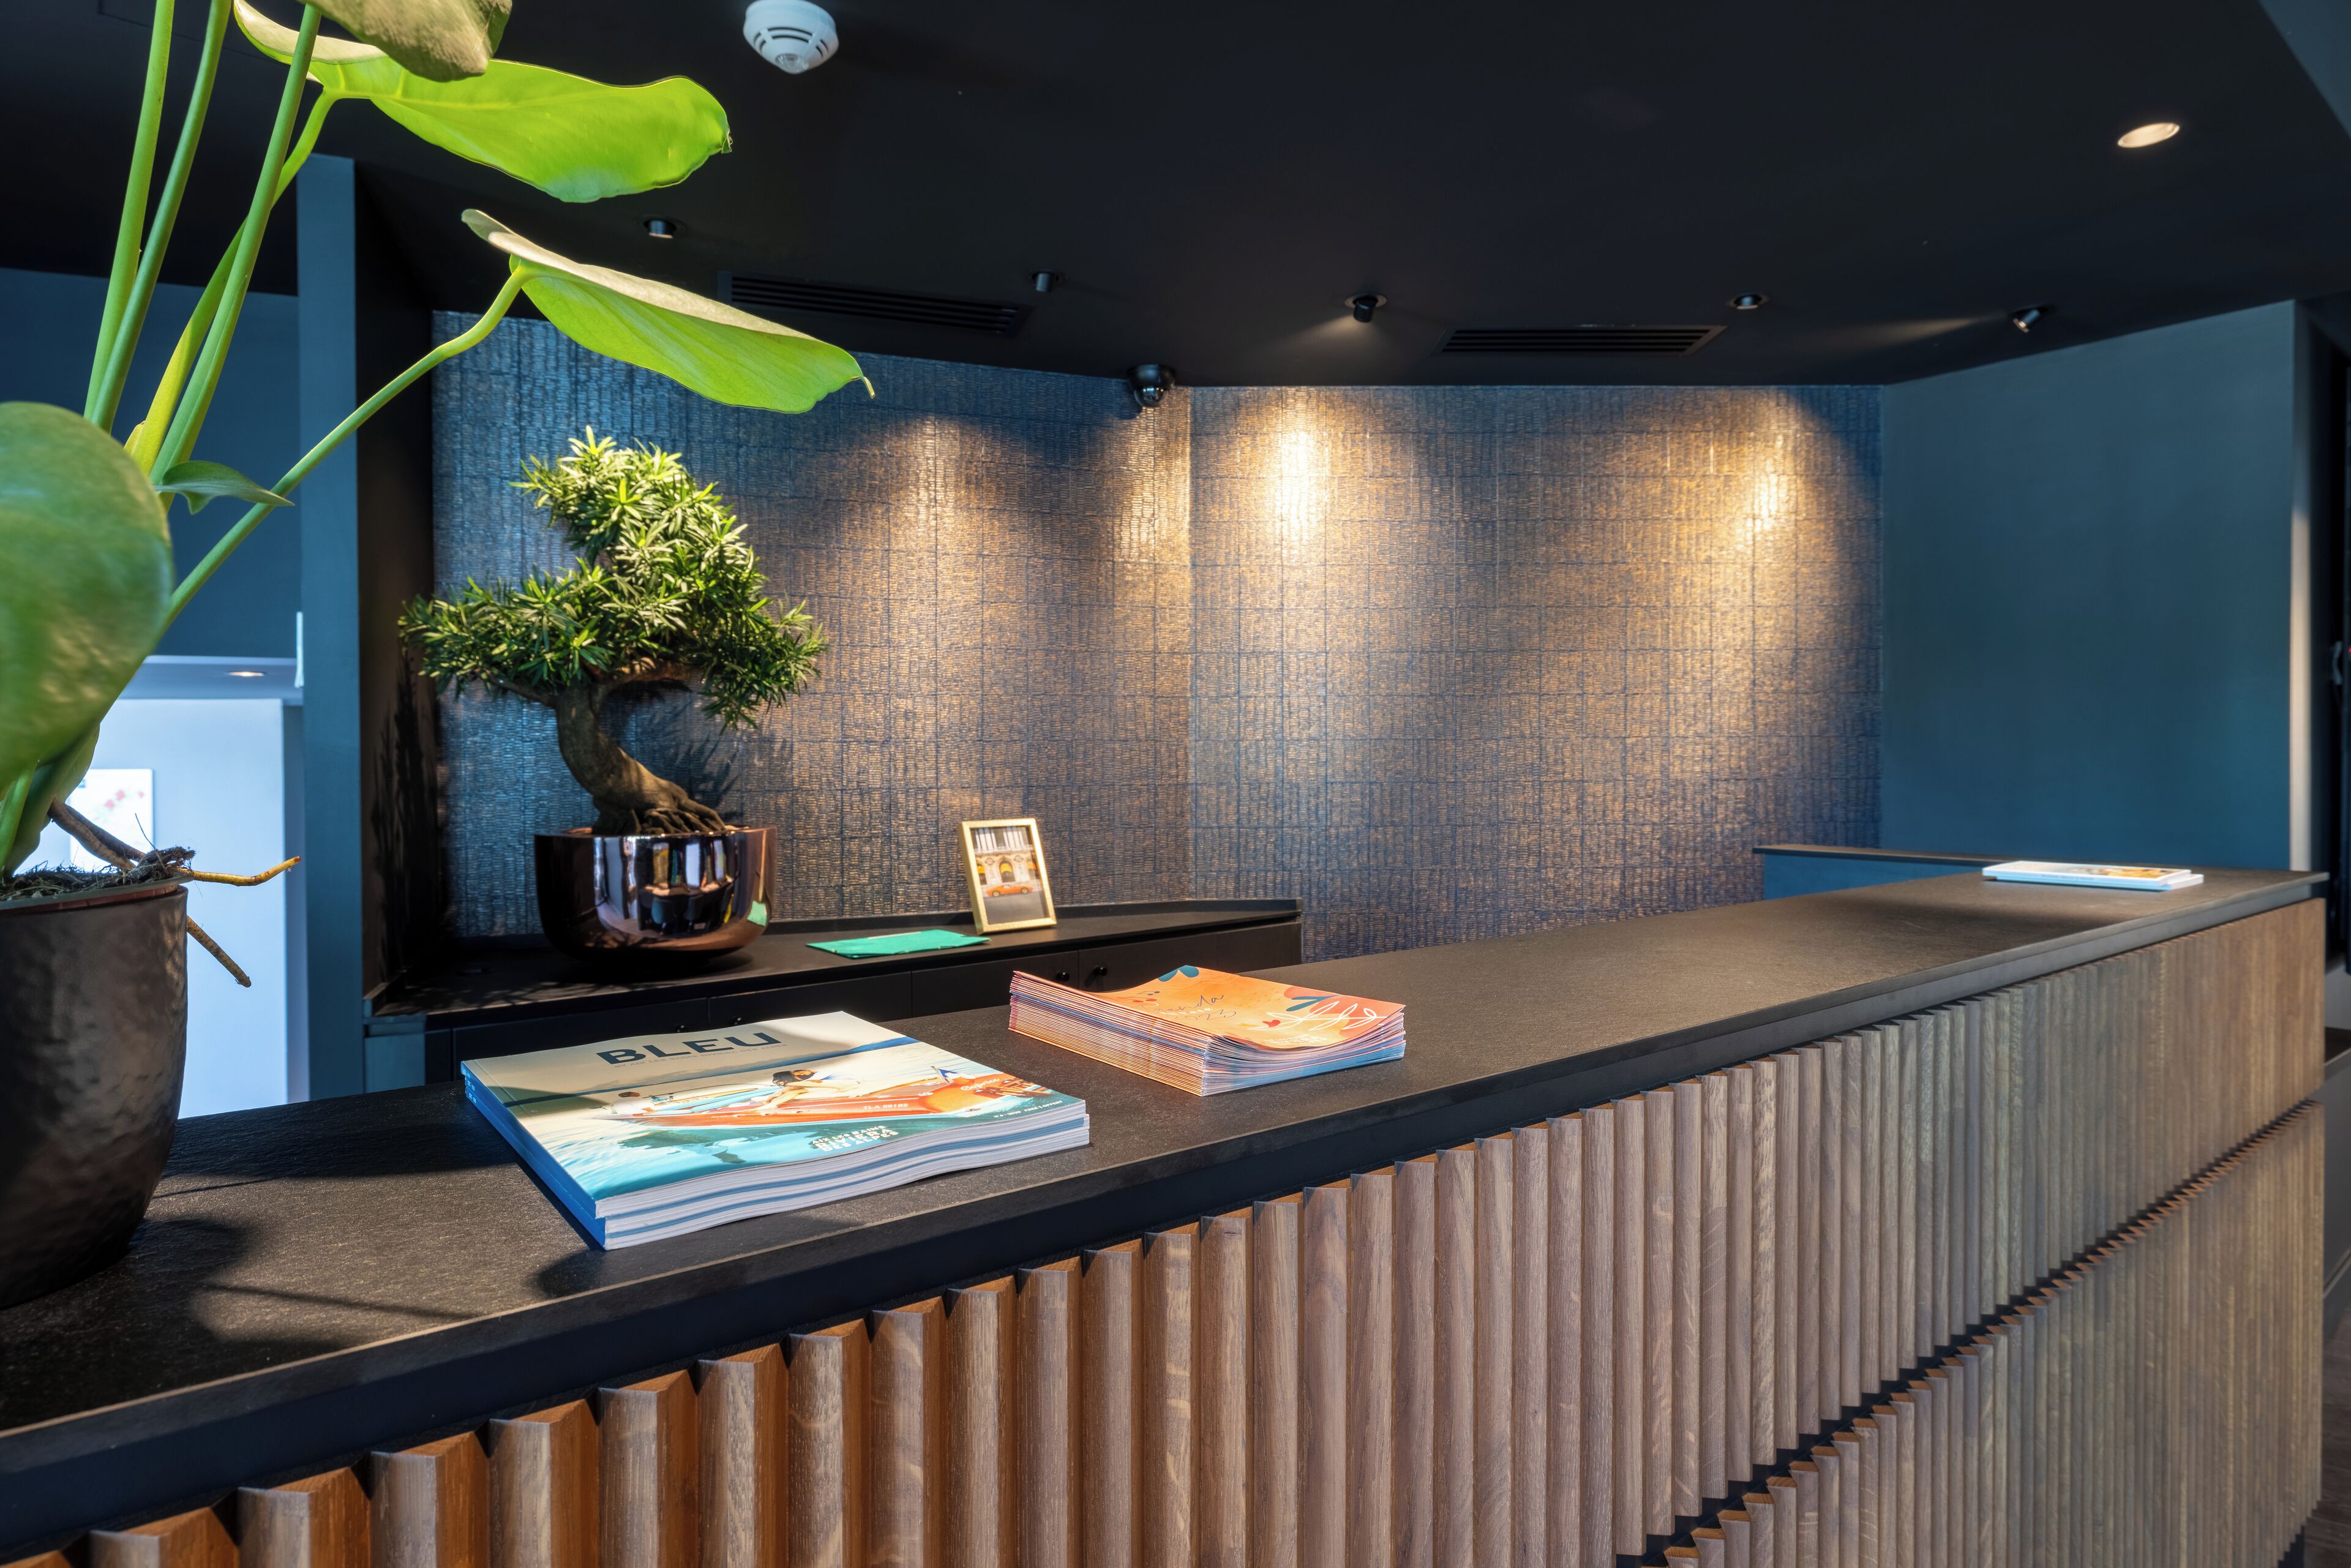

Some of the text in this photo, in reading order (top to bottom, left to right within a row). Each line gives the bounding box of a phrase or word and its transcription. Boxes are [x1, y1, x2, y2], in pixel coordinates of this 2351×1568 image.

[596, 1032, 782, 1065] BLEU
[960, 1078, 1000, 1090] Caprice
[815, 1128, 893, 1149] RIVIERA
[851, 1125, 886, 1136] BAINS
[822, 1131, 899, 1152] DES ALPES
